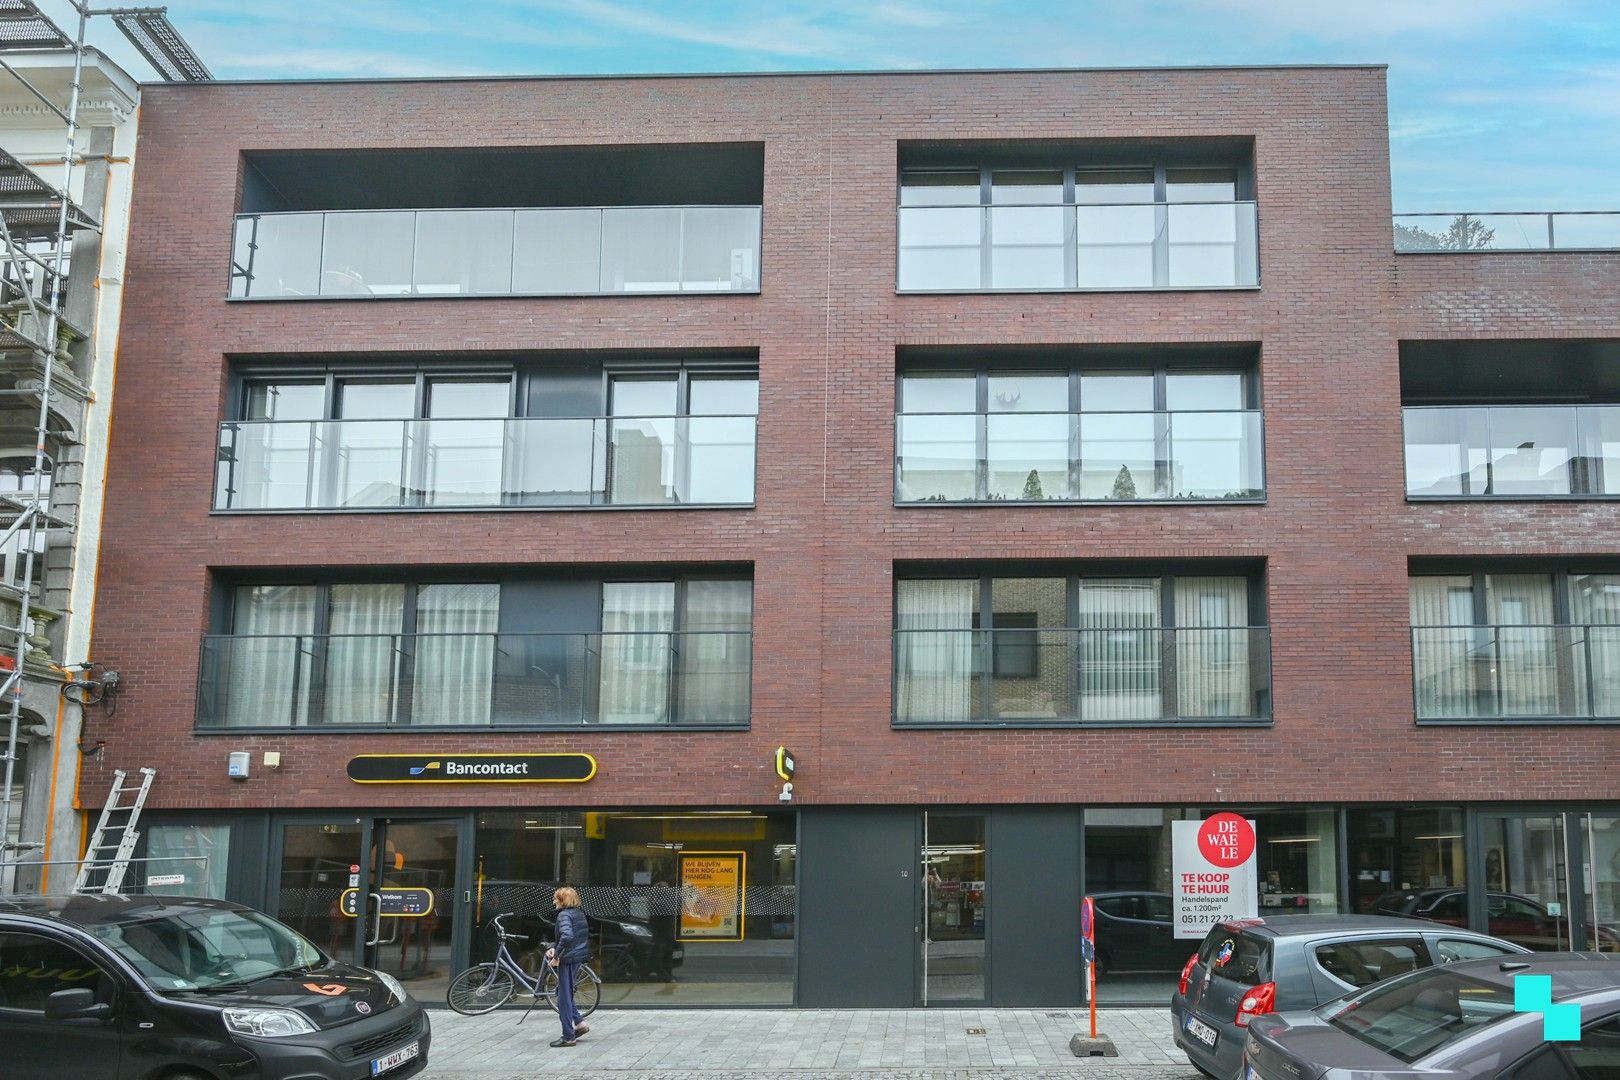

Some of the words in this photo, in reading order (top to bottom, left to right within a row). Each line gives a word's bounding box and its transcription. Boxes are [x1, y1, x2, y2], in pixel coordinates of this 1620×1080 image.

[447, 761, 528, 775] Bancontact
[1219, 821, 1238, 833] DE
[1207, 834, 1238, 846] WAE
[1221, 847, 1239, 859] LE
[1181, 873, 1196, 882] TE
[1197, 873, 1230, 882] KOOP
[1181, 885, 1196, 894] TE
[1197, 885, 1230, 894] HUUR
[1181, 896, 1229, 904] Handelspand
[1182, 915, 1197, 924] 051
[1199, 915, 1208, 923] 21
[1210, 915, 1221, 923] 22
